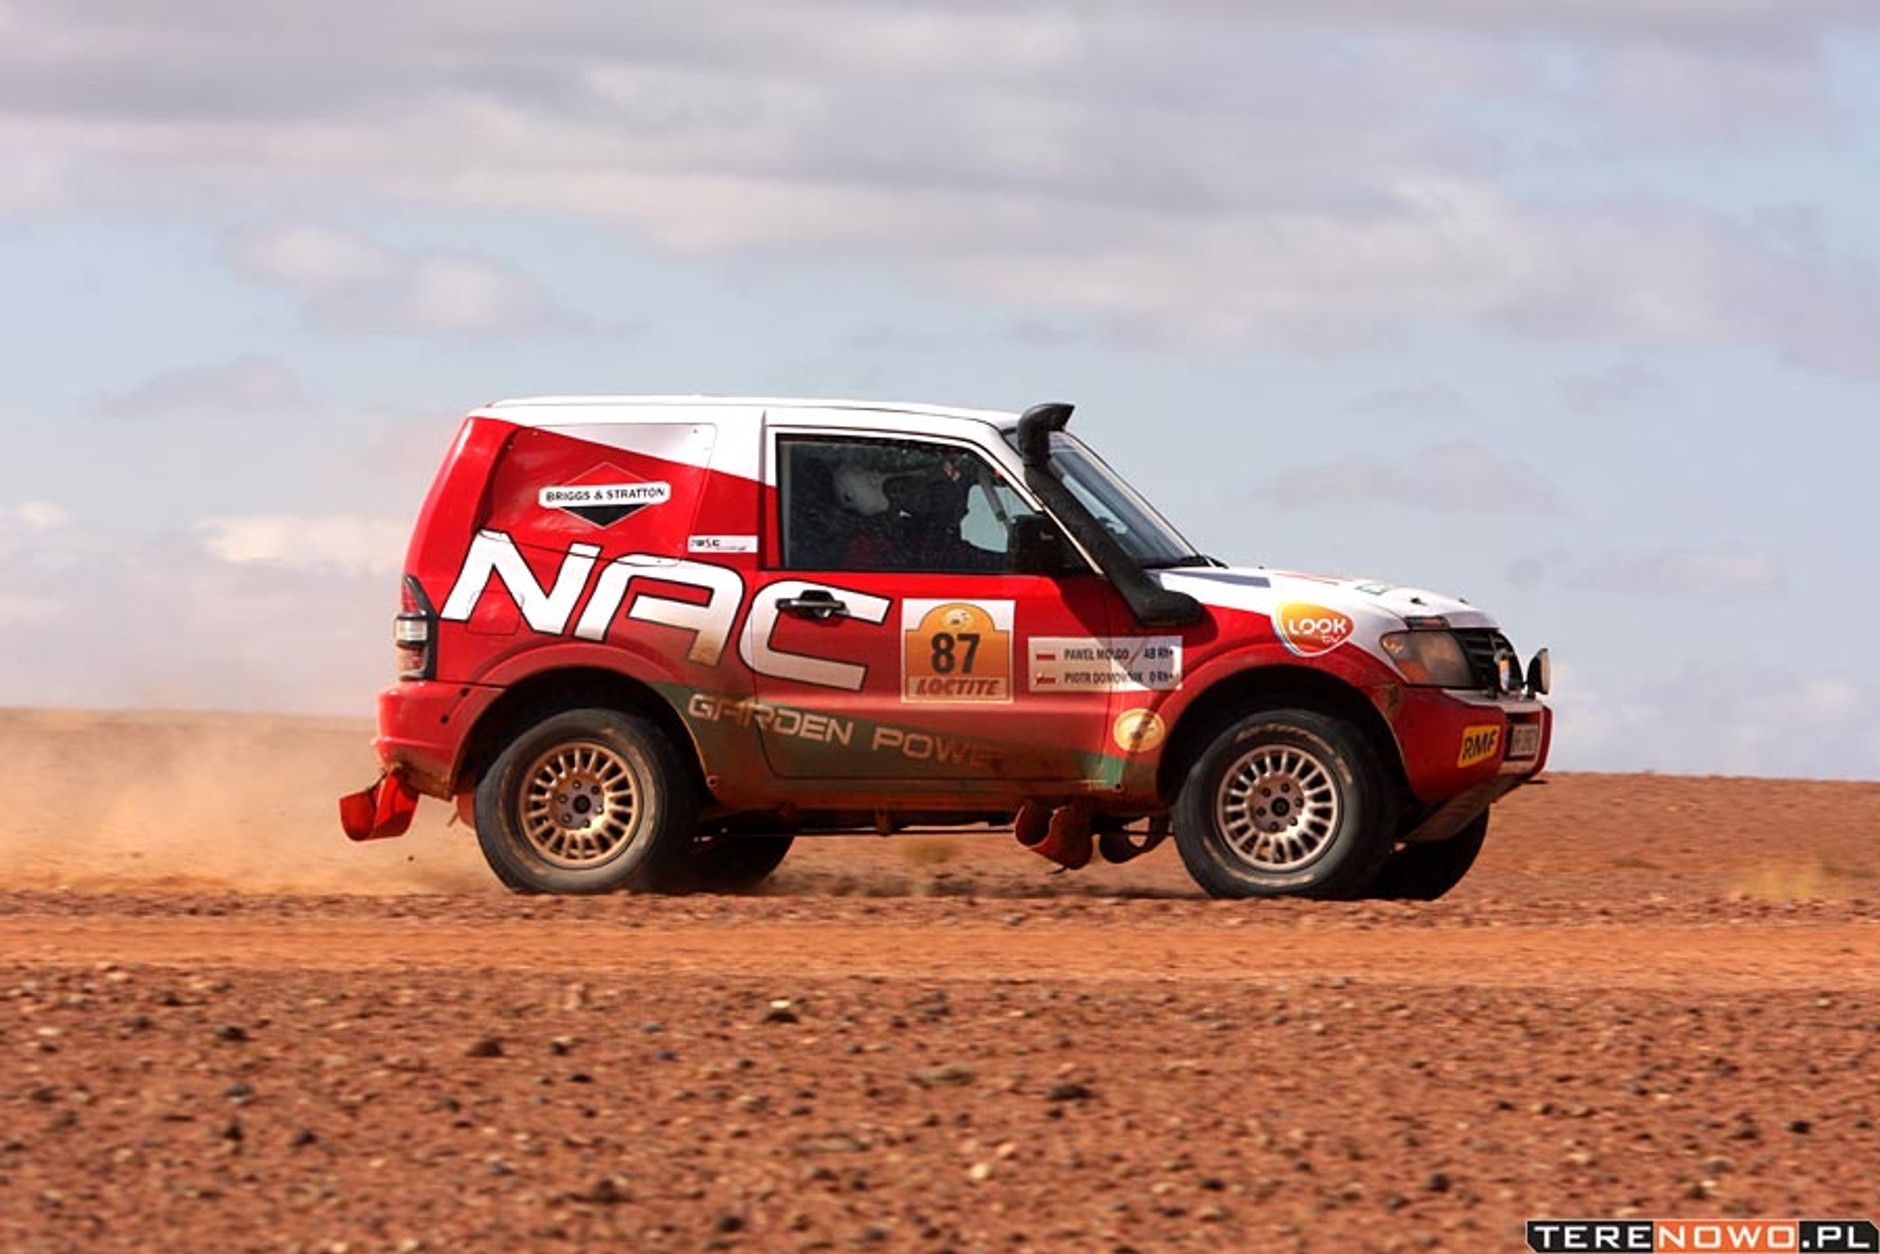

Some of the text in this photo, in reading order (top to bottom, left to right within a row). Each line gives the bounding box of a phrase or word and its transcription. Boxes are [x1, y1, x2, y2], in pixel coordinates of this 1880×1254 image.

[545, 486, 666, 502] BRIGGS & STRATTON
[440, 529, 890, 693] NAC
[1288, 618, 1347, 636] LOOK
[931, 632, 980, 674] 87
[915, 679, 1000, 696] LOCTITE
[1064, 672, 1092, 684] PIOTR
[687, 693, 854, 746] GARDEN
[1462, 728, 1498, 760] RMF
